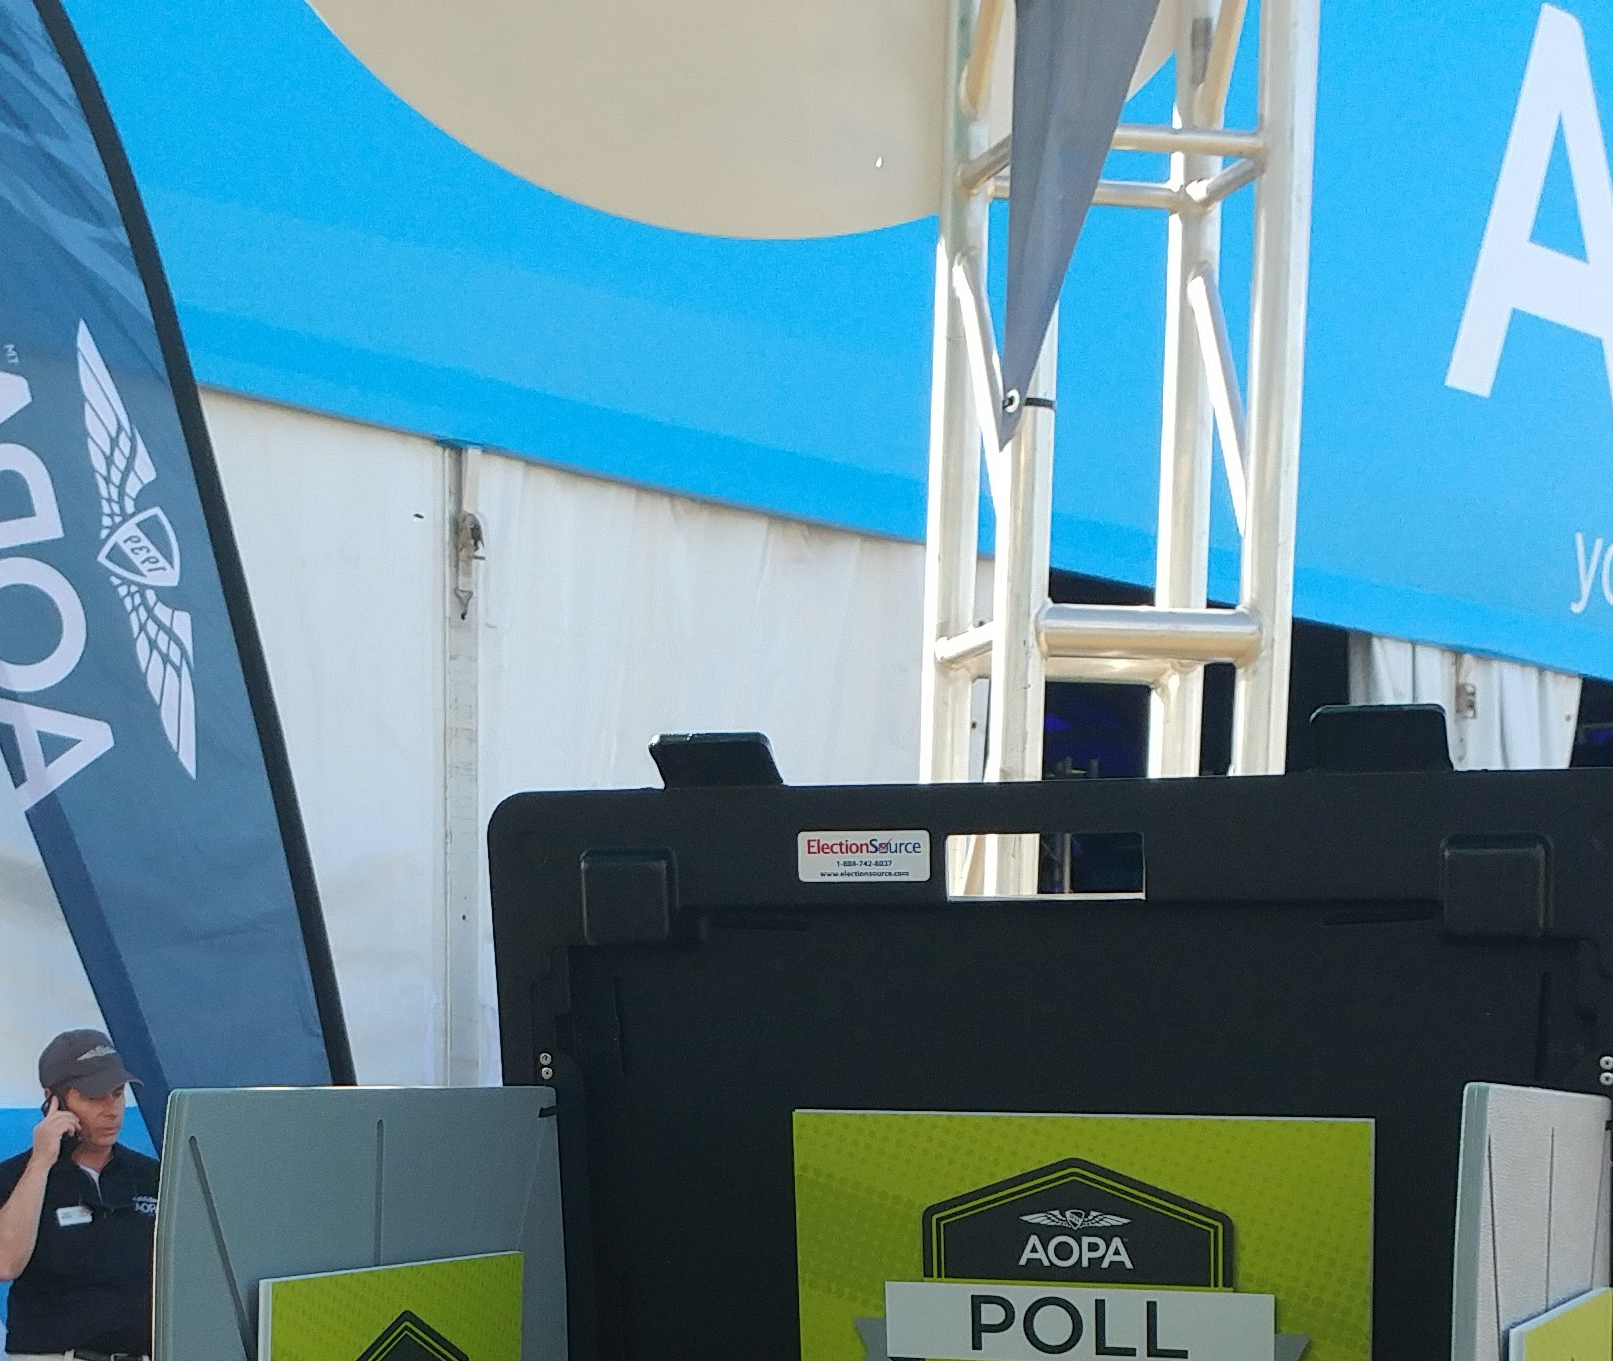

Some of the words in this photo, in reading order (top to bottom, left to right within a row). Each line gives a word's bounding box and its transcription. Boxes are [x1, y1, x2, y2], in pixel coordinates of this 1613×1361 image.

[806, 837, 922, 855] ElectionSource
[1018, 1234, 1134, 1270] AOPA
[970, 1294, 1189, 1360] POLL
